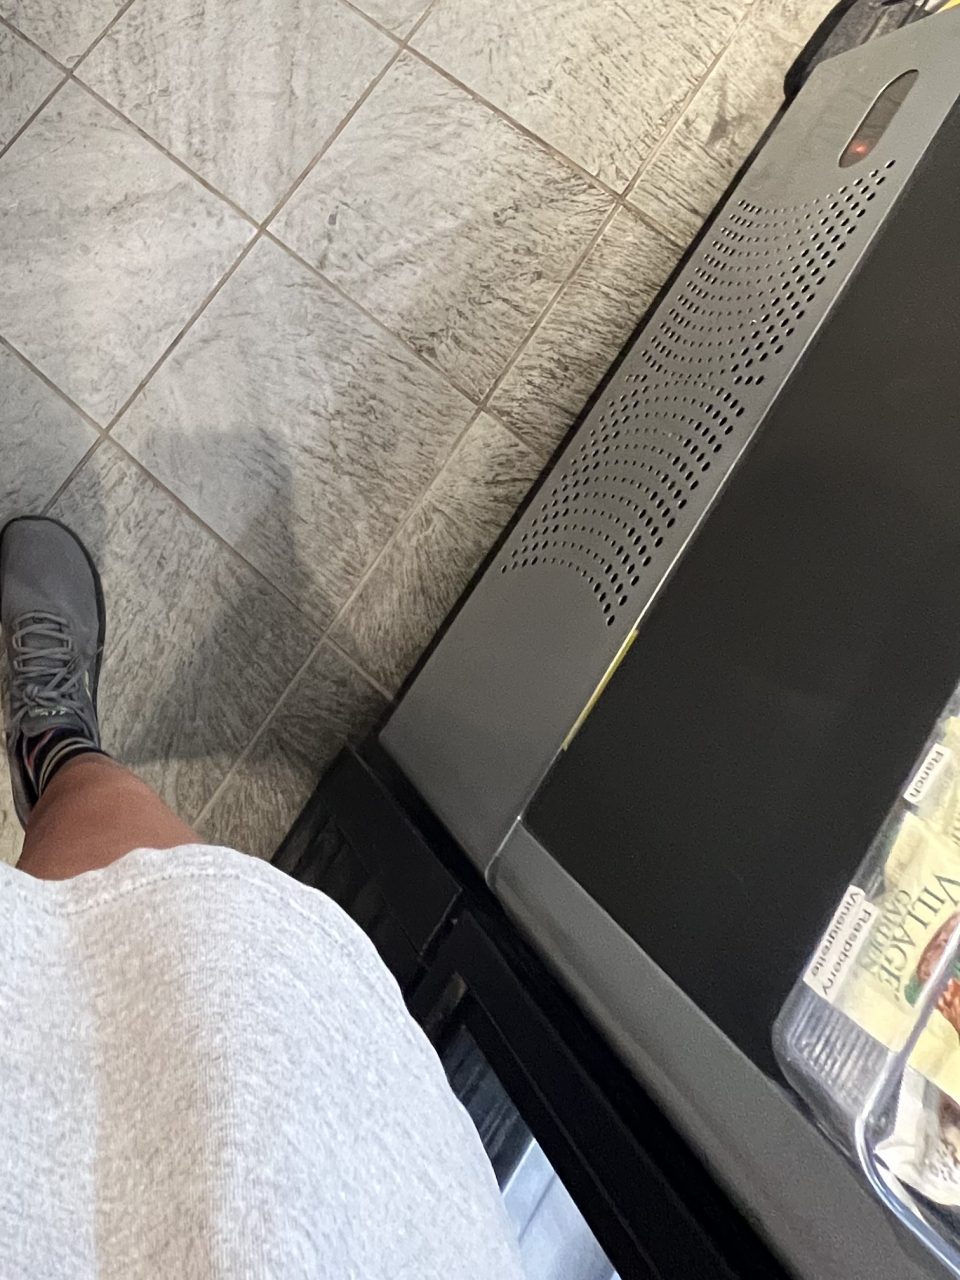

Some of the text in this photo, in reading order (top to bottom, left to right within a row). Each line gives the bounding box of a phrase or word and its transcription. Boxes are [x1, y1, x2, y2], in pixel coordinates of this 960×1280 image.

[907, 749, 945, 799] Ranch
[810, 891, 861, 978] Vinaigrette
[822, 909, 873, 997] Raspberry
[878, 873, 960, 989] VILLAGE
